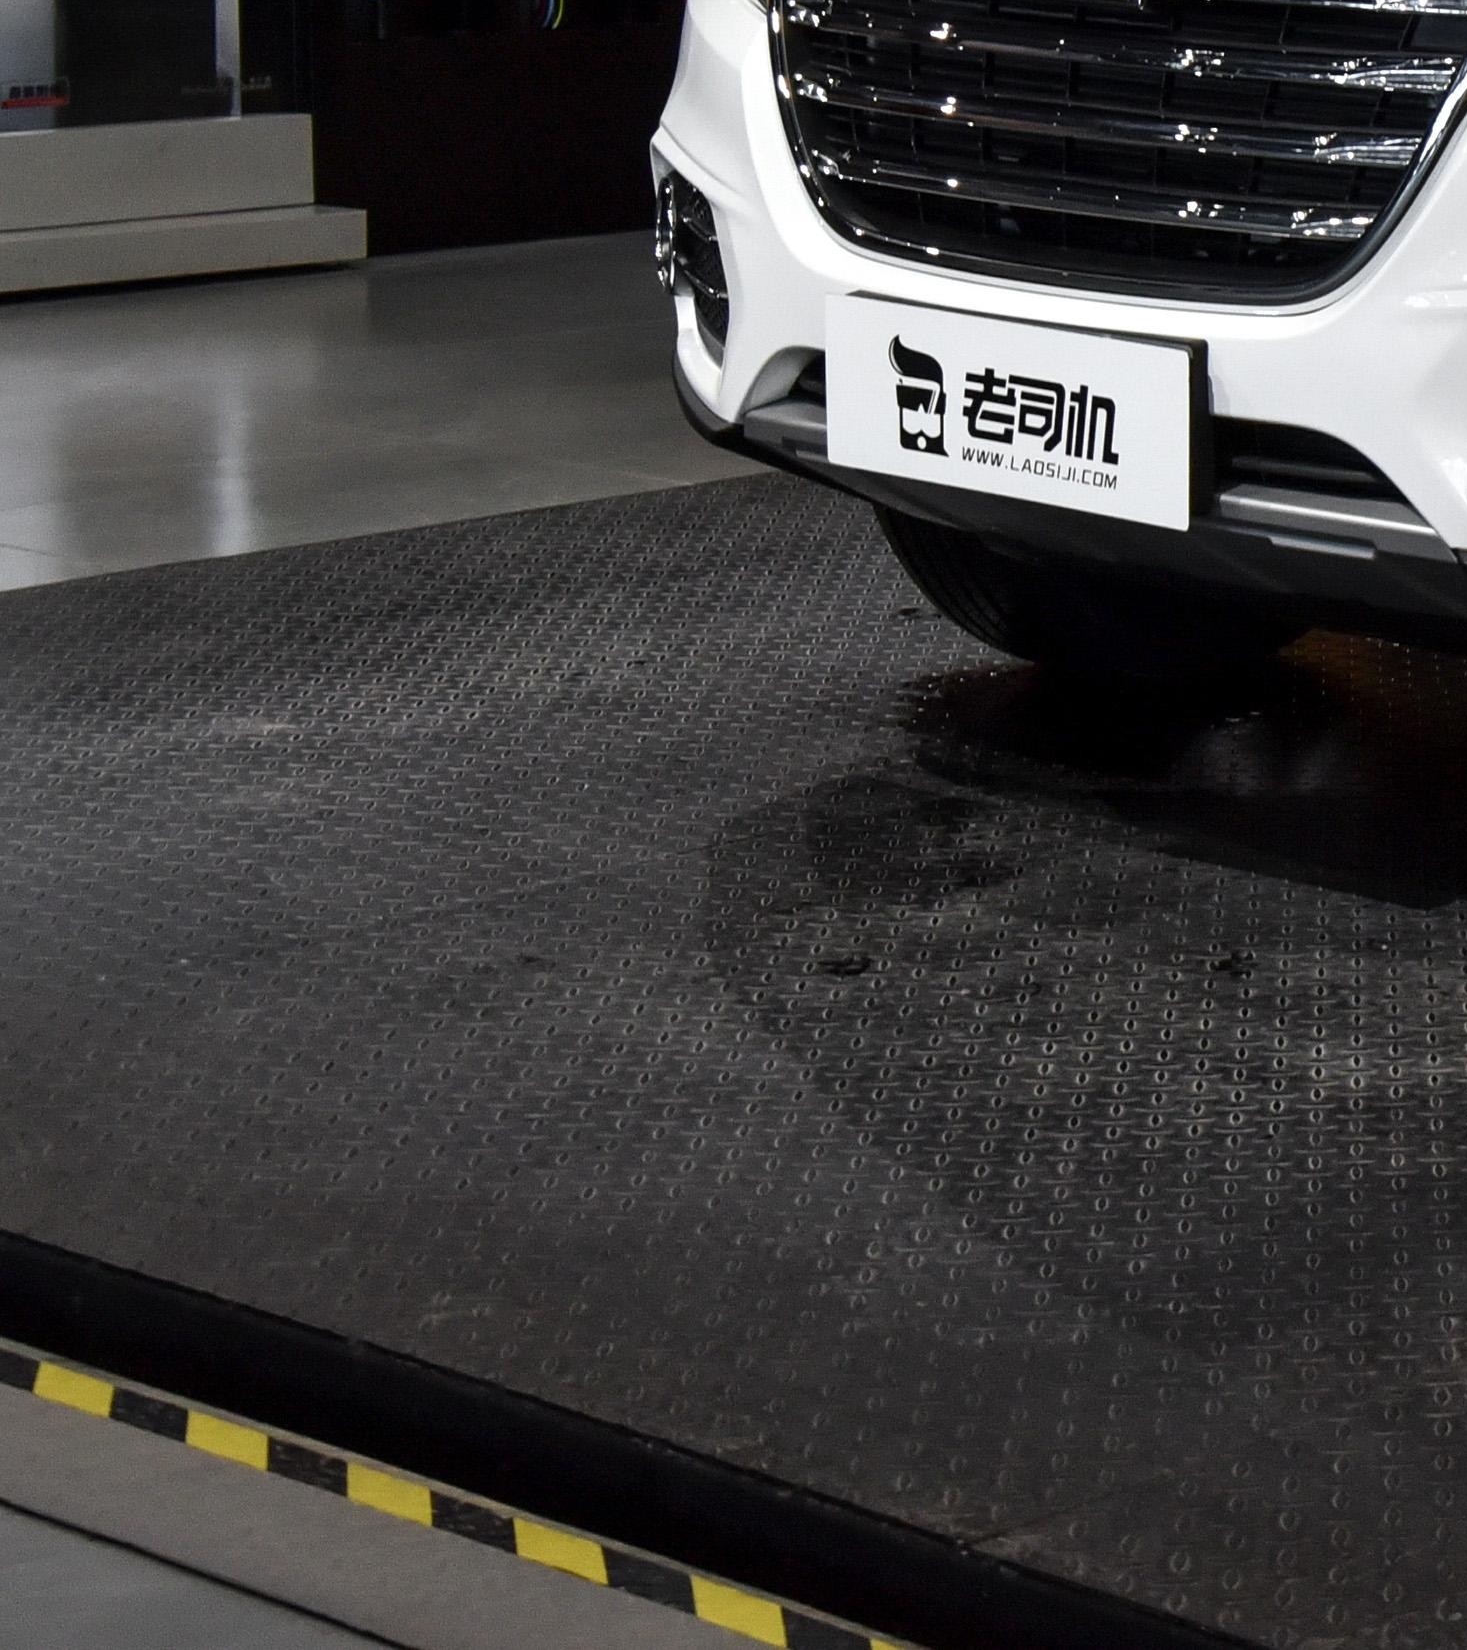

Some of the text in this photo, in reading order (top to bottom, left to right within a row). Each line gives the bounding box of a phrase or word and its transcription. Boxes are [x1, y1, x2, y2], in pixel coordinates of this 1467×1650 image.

[961, 367, 1120, 466] 老司机
[961, 444, 1119, 491] WWW.LAOSIJI.COM
